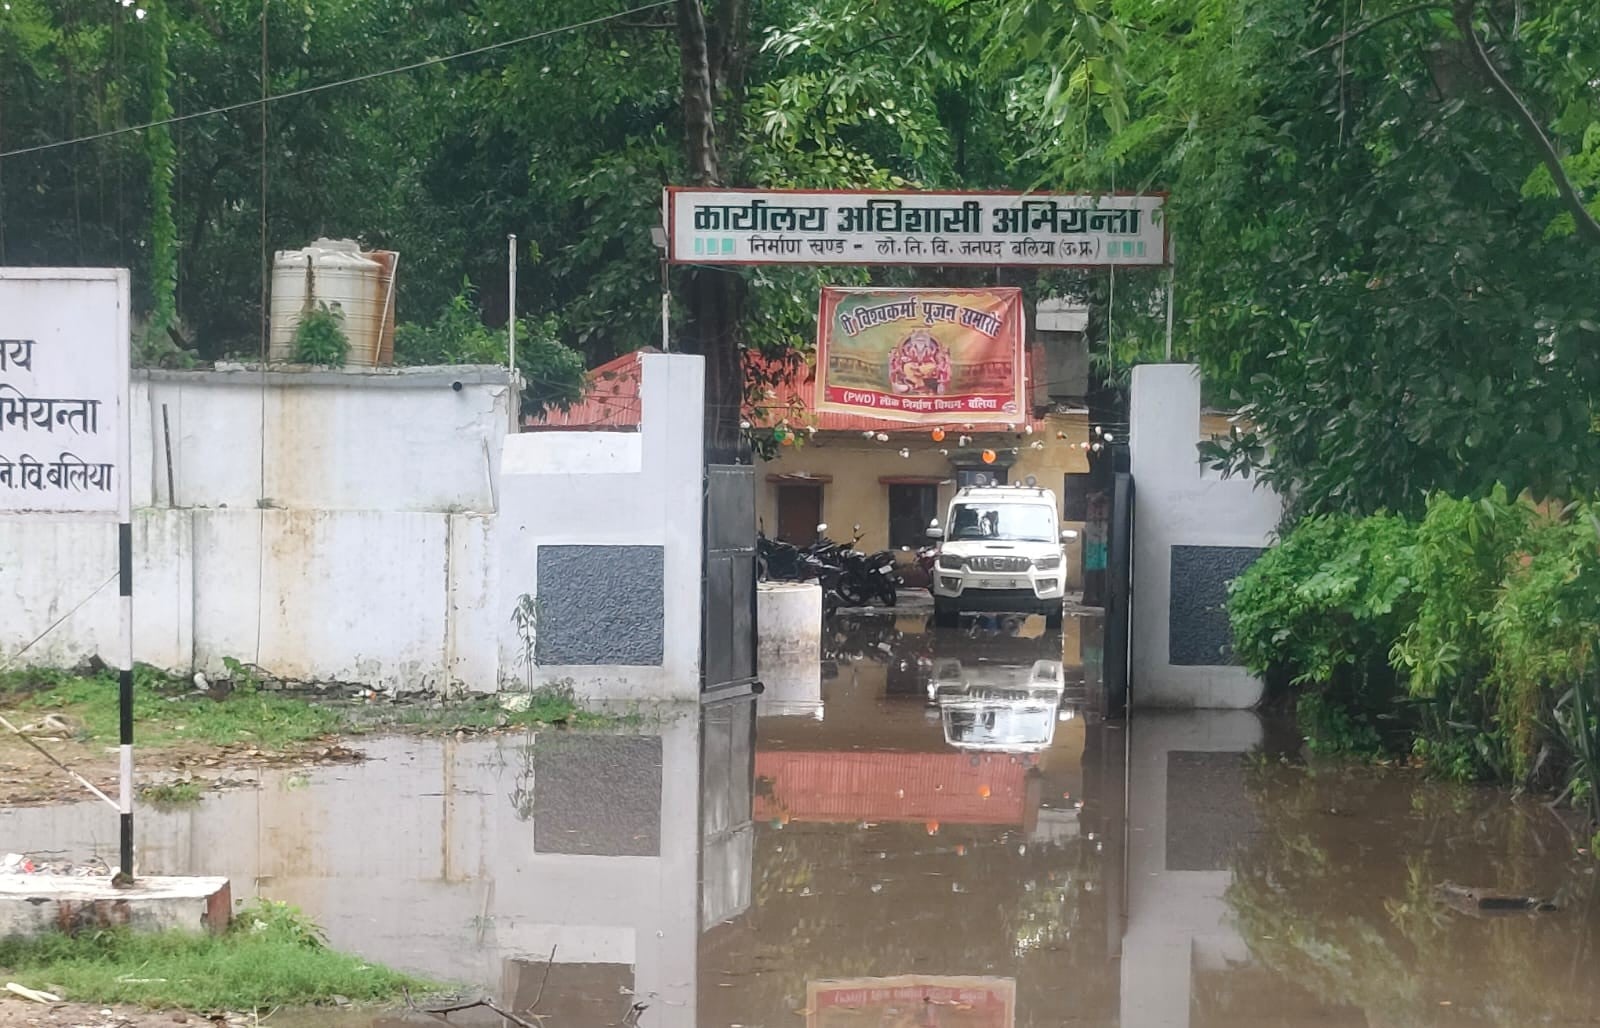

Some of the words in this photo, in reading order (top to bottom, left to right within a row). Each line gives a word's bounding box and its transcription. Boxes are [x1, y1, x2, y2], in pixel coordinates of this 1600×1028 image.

[694, 199, 829, 232] कार्यालय
[837, 199, 983, 233] अधिशासी
[747, 235, 803, 256] निर्माण
[807, 237, 847, 255] खण्ड
[958, 239, 1004, 258] जनपद
[1009, 237, 1056, 257] बलिया
[921, 301, 958, 323] पूजन
[843, 391, 876, 406] (PWD)
